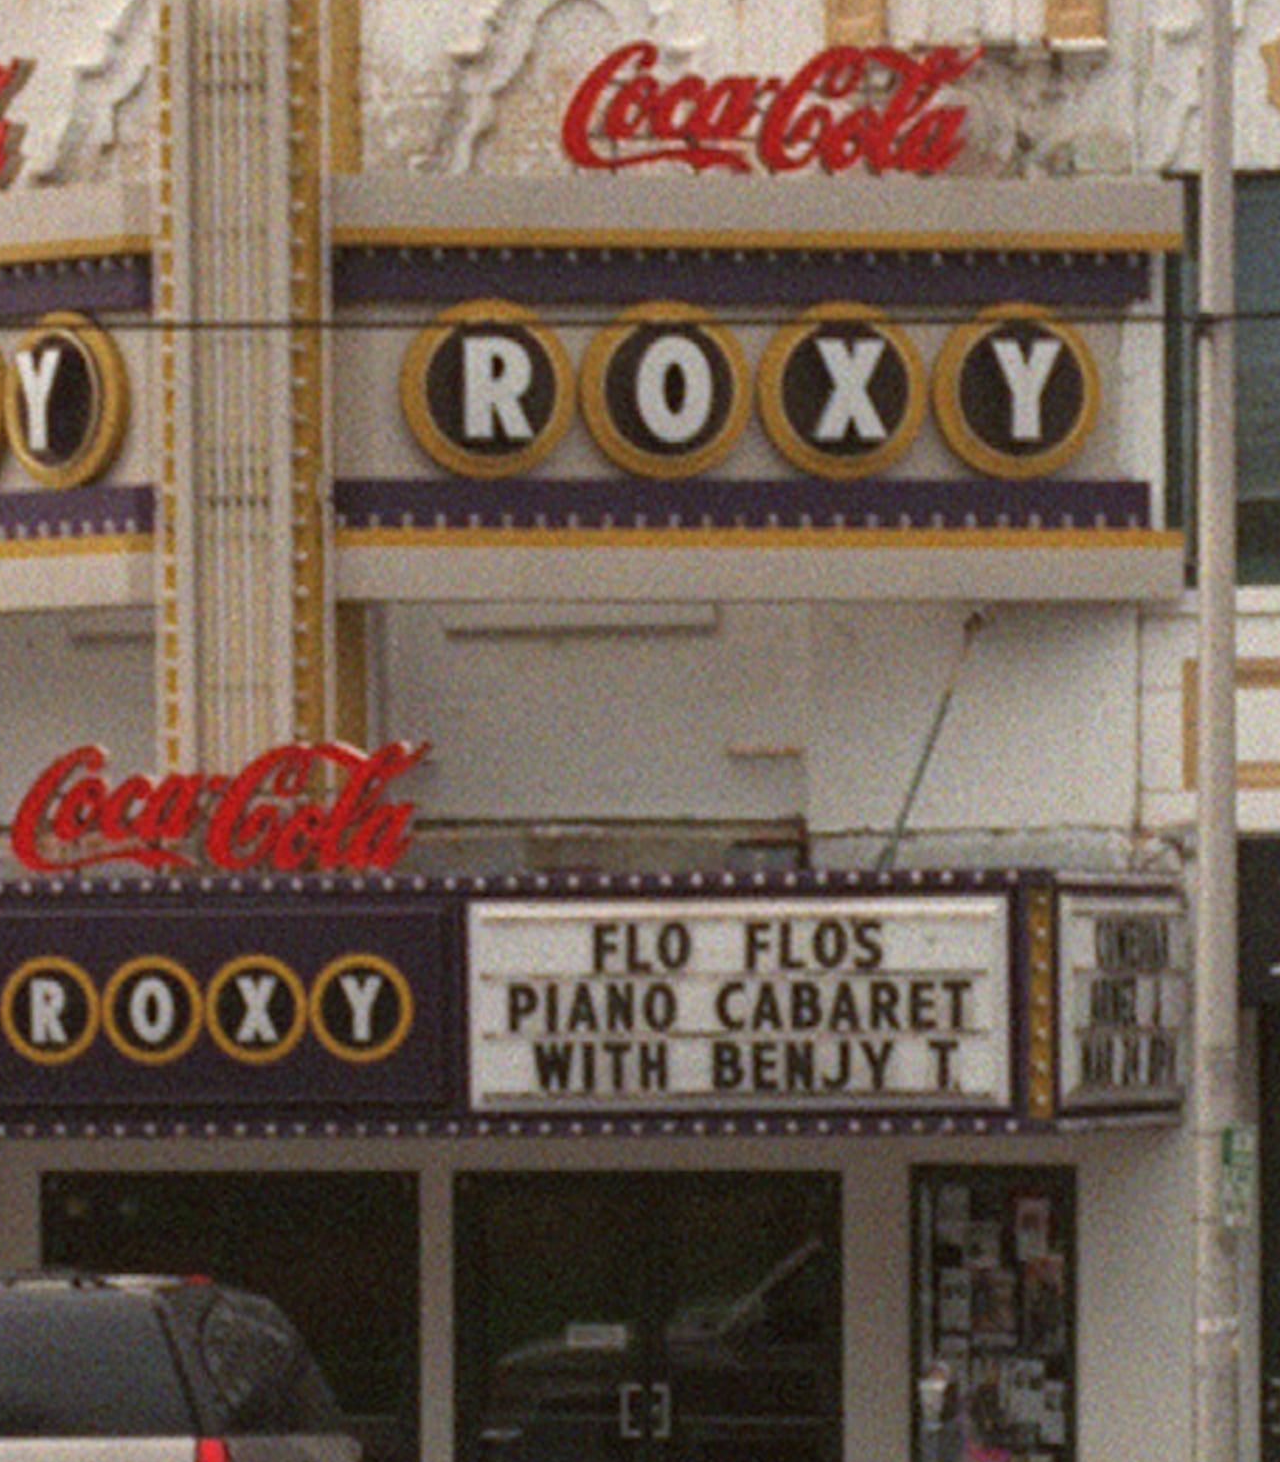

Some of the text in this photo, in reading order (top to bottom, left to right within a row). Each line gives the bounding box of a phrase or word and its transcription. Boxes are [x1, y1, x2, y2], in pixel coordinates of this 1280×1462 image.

[562, 41, 986, 175] Coca-Cola
[462, 335, 1062, 443] ROXY
[592, 921, 691, 974] FLO
[31, 975, 383, 1044] ROXY
[506, 979, 972, 1033] PIANO CABARET
[533, 1041, 669, 1092] WITH
[712, 1040, 896, 1091] BENJY
